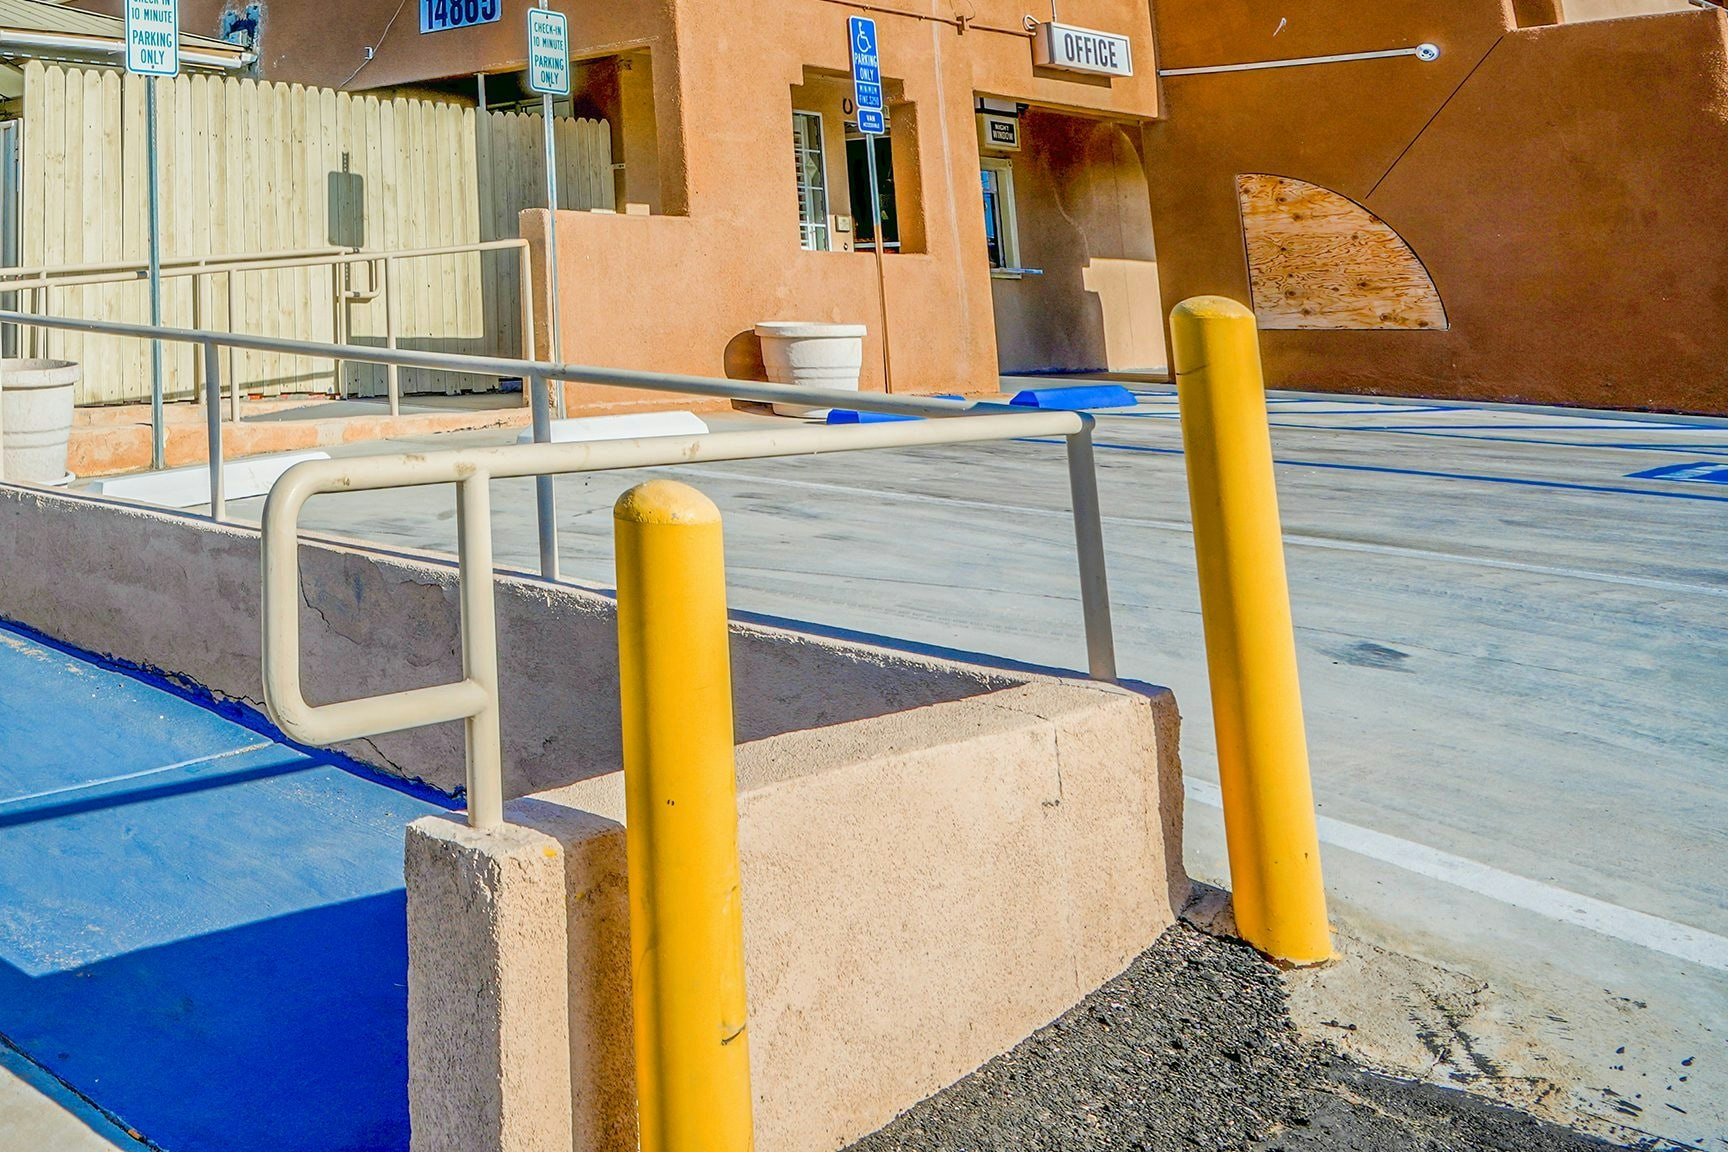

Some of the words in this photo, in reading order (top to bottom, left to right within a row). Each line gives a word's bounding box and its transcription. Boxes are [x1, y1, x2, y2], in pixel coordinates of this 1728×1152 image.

[131, 7, 140, 20] 10
[144, 8, 172, 23] MINUTE
[534, 22, 562, 36] CHECK-IN
[132, 29, 172, 48] PARKING
[533, 35, 540, 47] 10
[542, 37, 563, 51] MINUTE
[140, 48, 165, 65] ONLY
[1064, 32, 1118, 69] OFFICE
[534, 54, 564, 71] PARKING
[854, 52, 878, 68] PARKING
[540, 70, 559, 85] ONLY
[859, 67, 874, 81] ONLY
[866, 114, 876, 122] VAN
[992, 129, 1014, 141] WINDOW
[994, 123, 1009, 132] NIGHT
